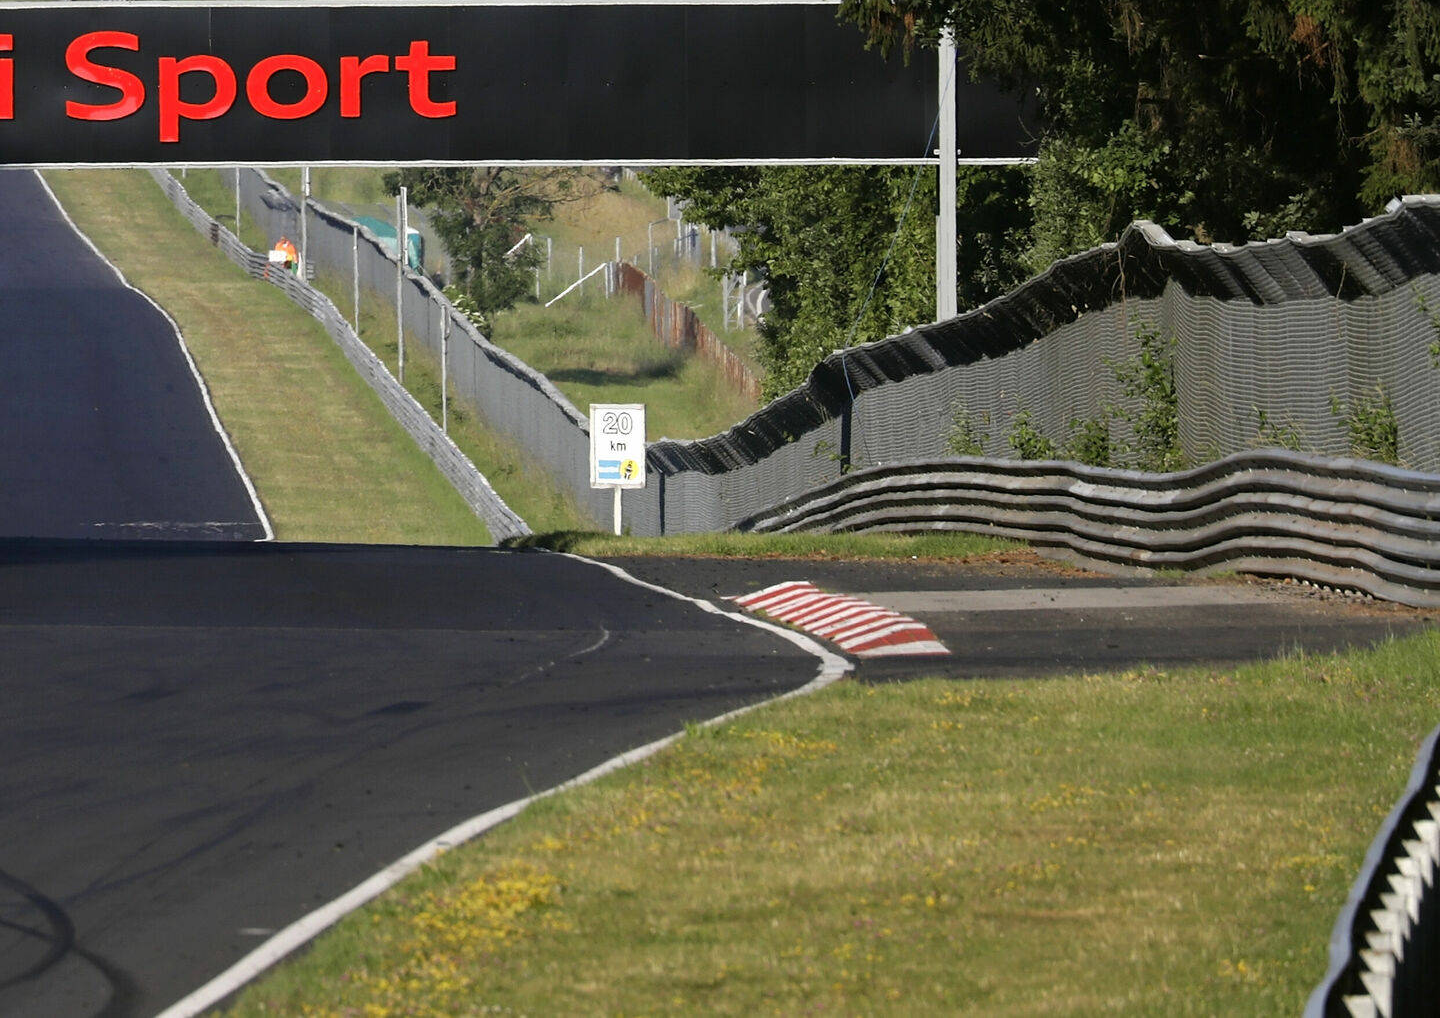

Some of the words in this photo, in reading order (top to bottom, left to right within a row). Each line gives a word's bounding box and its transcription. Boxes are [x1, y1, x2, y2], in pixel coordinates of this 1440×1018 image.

[65, 31, 457, 143] Sport
[603, 412, 633, 435] 20
[610, 441, 626, 451] km
